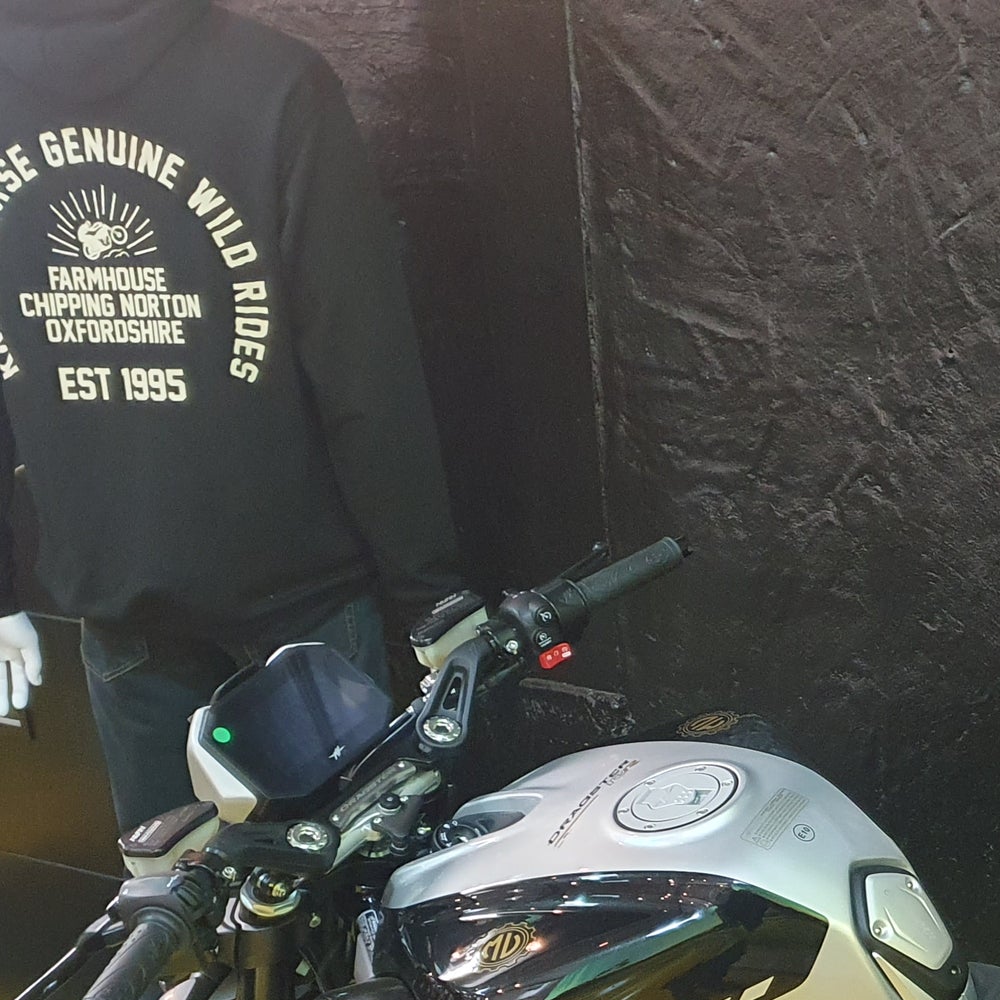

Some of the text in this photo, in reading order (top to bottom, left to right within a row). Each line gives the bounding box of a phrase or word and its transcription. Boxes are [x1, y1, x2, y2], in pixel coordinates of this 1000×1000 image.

[39, 127, 185, 190] GENUINE
[187, 177, 258, 269] WILD
[229, 280, 270, 384] RIDES
[48, 266, 167, 292] FARMHOUSE
[19, 293, 202, 318] CHIPPING NORTON
[45, 319, 186, 345] OXFORDSHIRE
[58, 366, 188, 402] EST 1995
